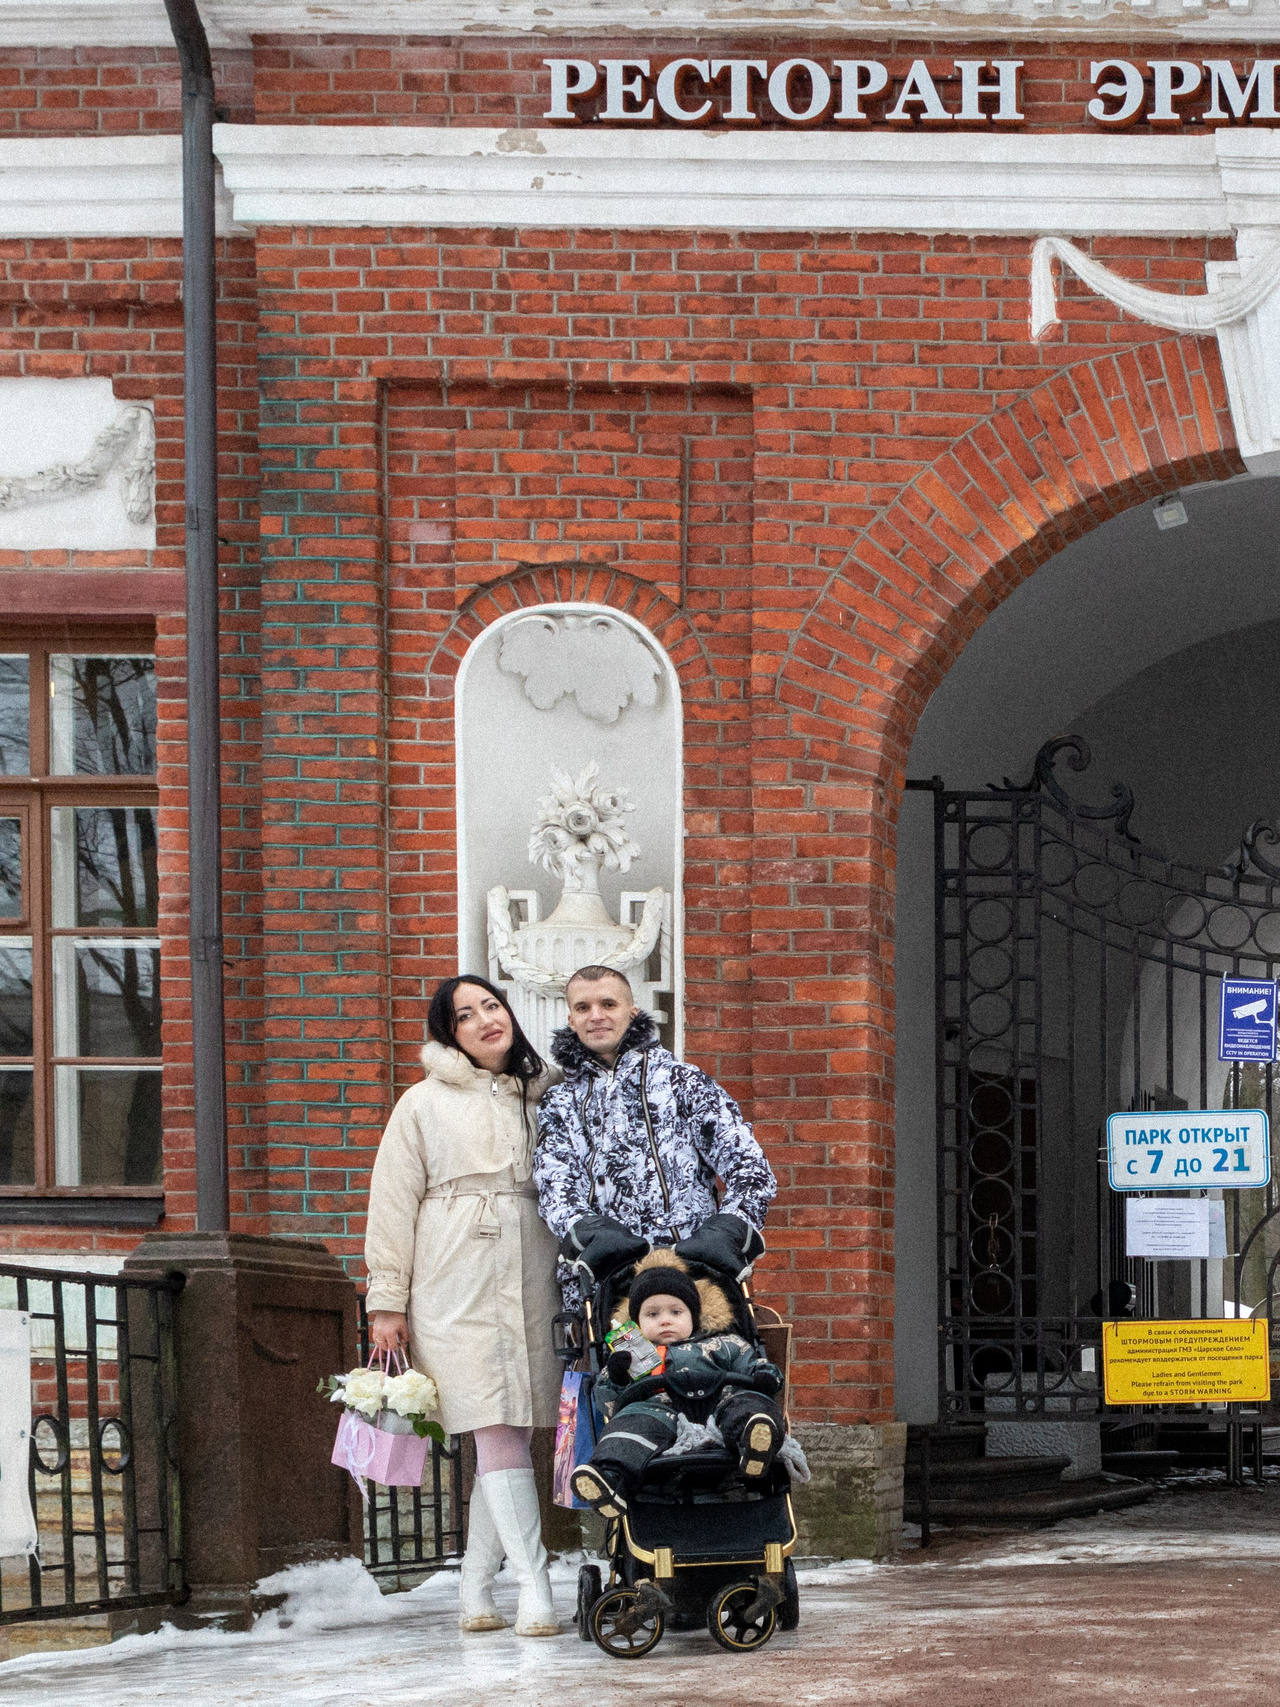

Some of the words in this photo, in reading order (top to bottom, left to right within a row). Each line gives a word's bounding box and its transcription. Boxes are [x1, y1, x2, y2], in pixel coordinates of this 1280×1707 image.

[542, 59, 1024, 121] РЕСТОРАН
[1227, 987, 1272, 995] ВНИМАНИЕ!
[1125, 1128, 1172, 1145] ПАРК
[1178, 1127, 1250, 1144] ОТКРЫТ
[1147, 1150, 1164, 1174] 7
[1212, 1147, 1250, 1173] 21
[1121, 1337, 1172, 1345] ШТОРМОВЫМ
[1173, 1335, 1251, 1344] ПРЕДУПРЕЖДЕНИЕМ
[1192, 1379, 1216, 1387] visiting
[1197, 1387, 1232, 1395] WARNING
